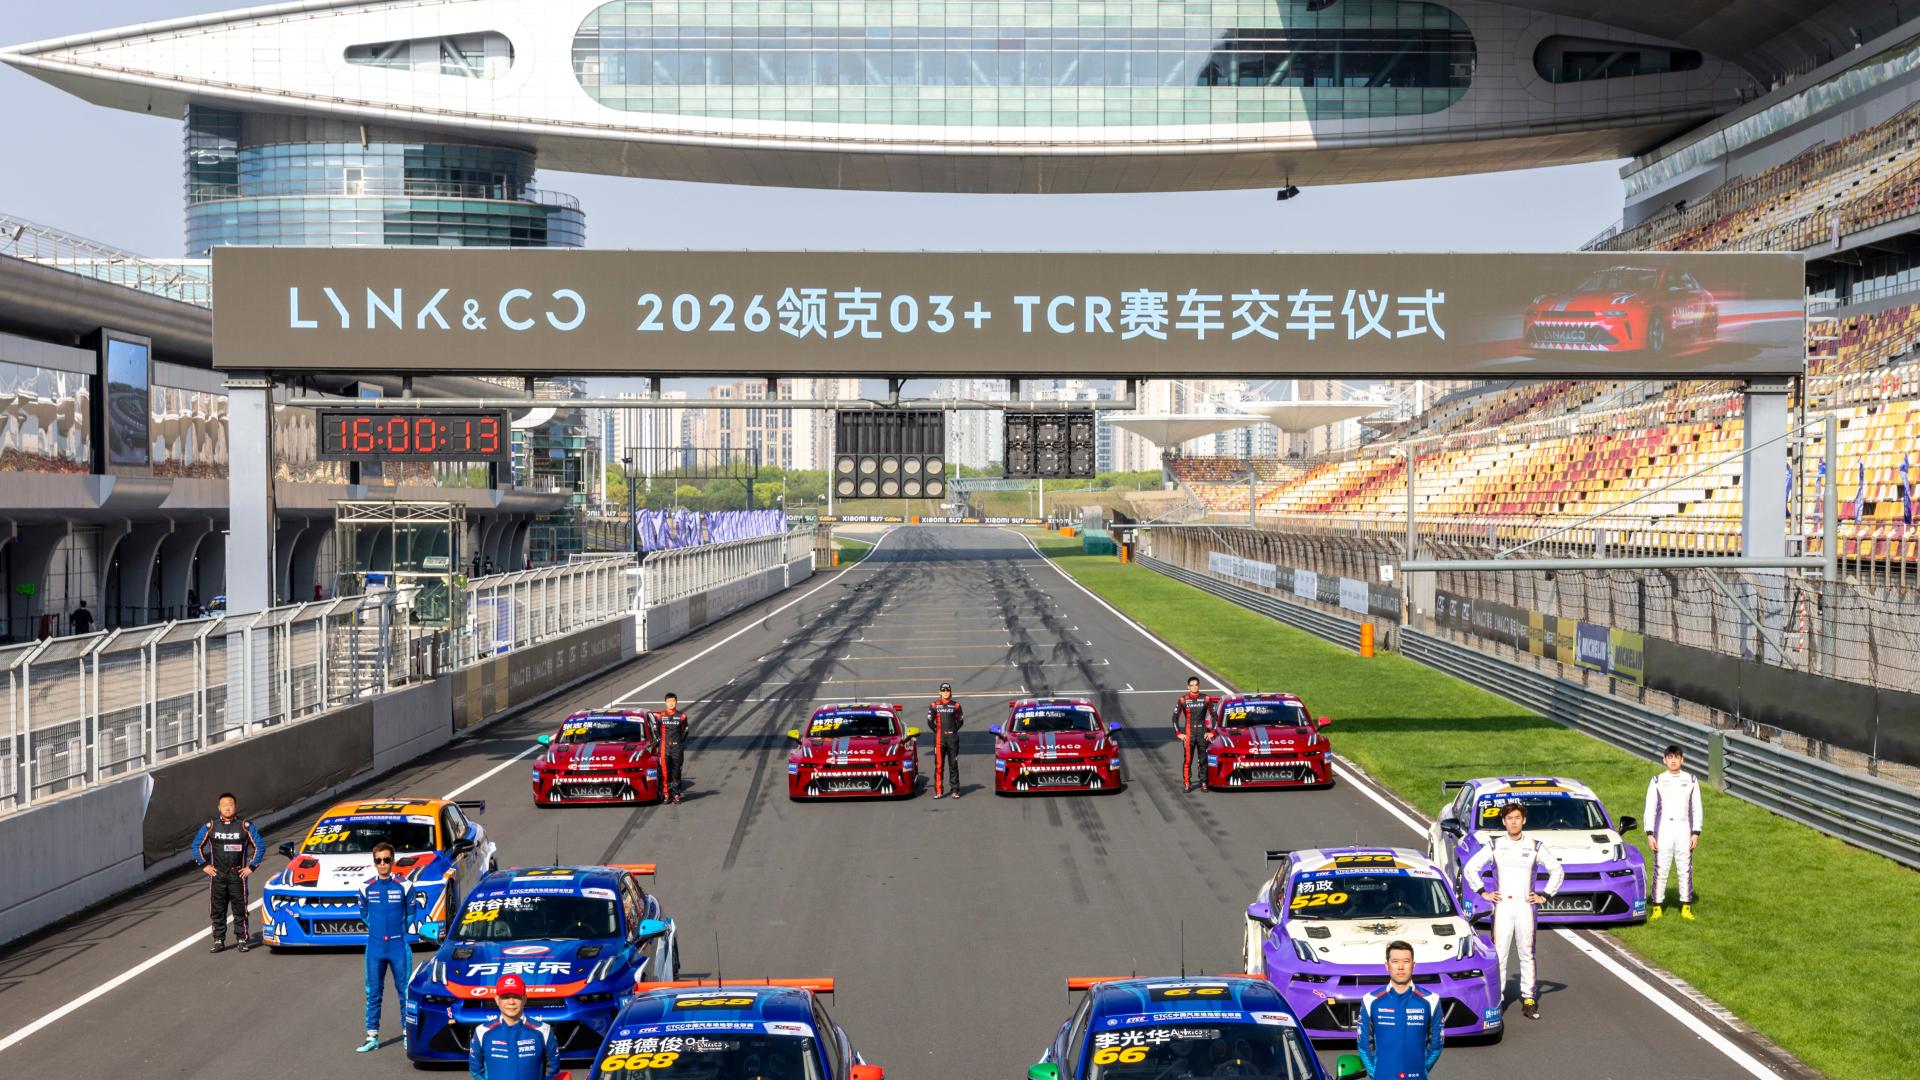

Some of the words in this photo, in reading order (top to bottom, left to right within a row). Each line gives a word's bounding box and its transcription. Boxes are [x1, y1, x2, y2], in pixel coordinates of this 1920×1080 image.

[289, 286, 587, 331] LYNK&CO
[637, 286, 992, 340] 2026领克03+
[1013, 287, 1446, 342] TCR赛车交车仪式
[340, 417, 499, 454] 16:00:13
[1037, 775, 1080, 784] LYNK&CO
[1251, 770, 1293, 779] LYNK&CO
[828, 781, 870, 789] LYNK&CO
[306, 830, 351, 846] 601
[313, 824, 343, 836] 王涛
[1297, 880, 1334, 894] 杨政
[467, 896, 522, 912] 符谷祥
[1289, 892, 1349, 910] 520
[461, 908, 500, 925] 94
[466, 961, 571, 976] 万家乐
[1164, 988, 1225, 996] 66
[676, 998, 754, 1007] 668
[608, 1036, 682, 1056] 潘德俊
[1094, 1029, 1171, 1049] 李光华
[600, 1051, 679, 1072] 668
[1093, 1046, 1150, 1066] 66
